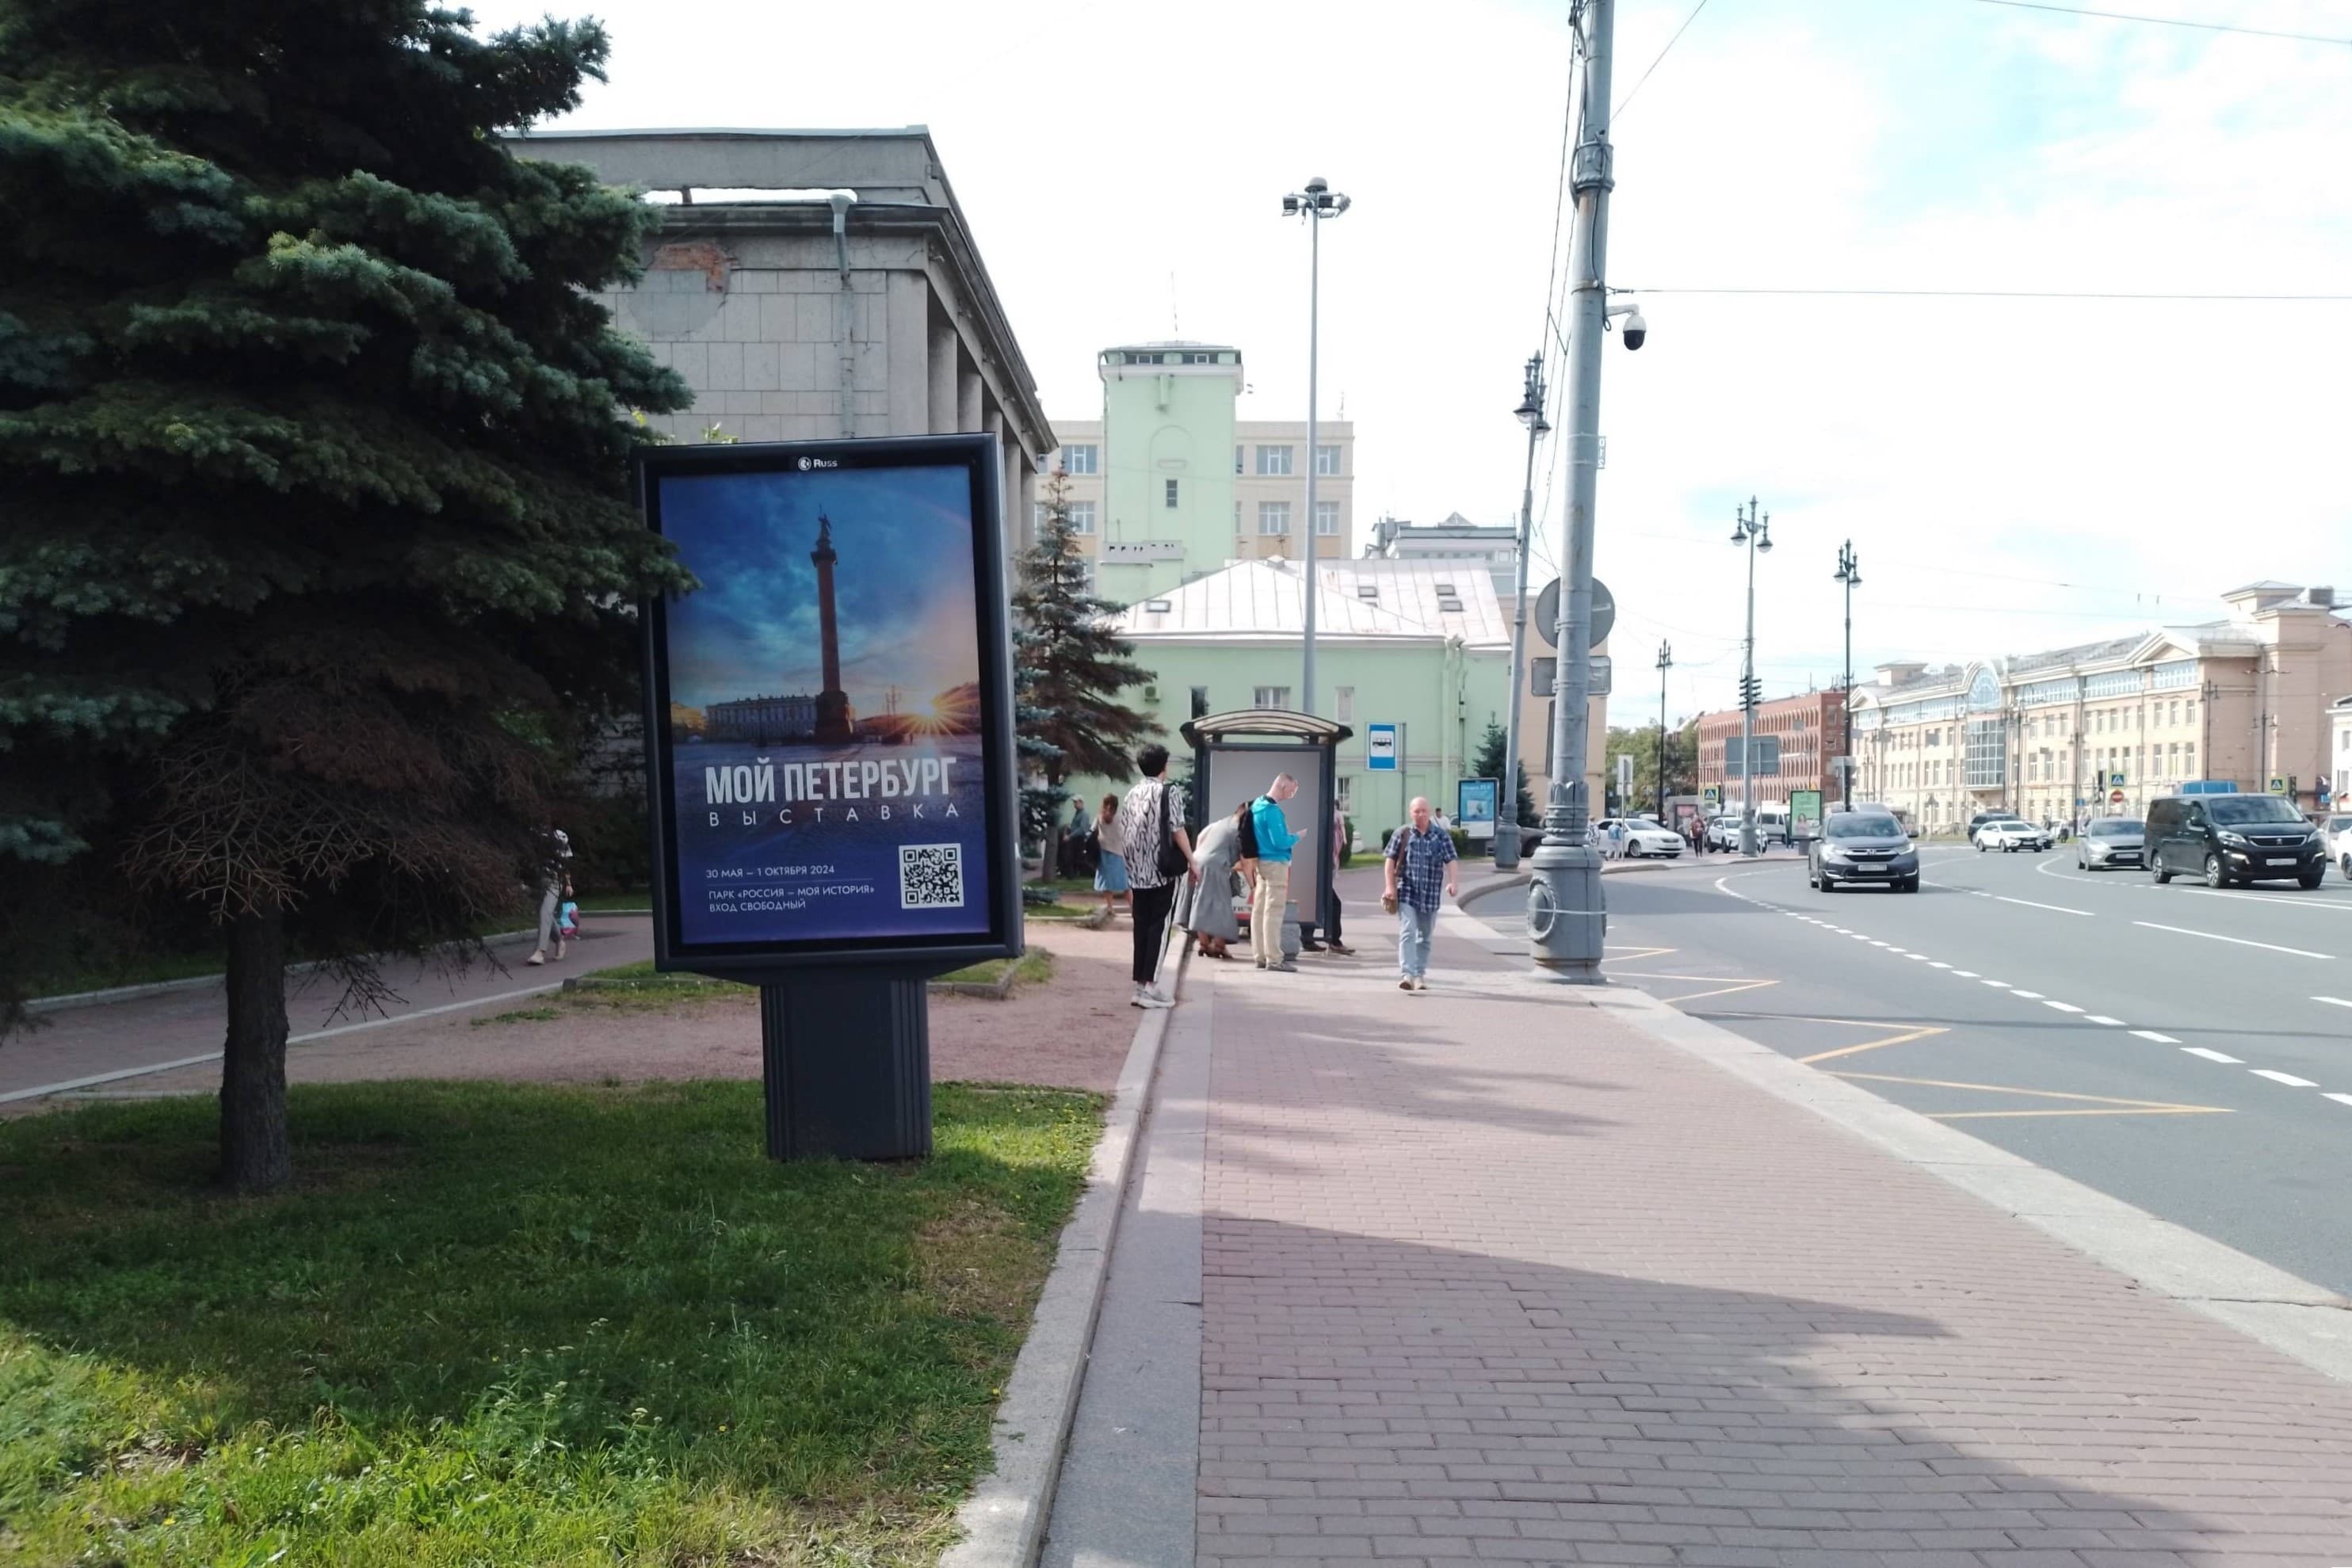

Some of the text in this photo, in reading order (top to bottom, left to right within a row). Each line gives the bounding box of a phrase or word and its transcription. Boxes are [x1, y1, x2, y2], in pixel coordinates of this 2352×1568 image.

[813, 458, 838, 467] Russ
[705, 757, 957, 804] МОЙ ПЕТЕРБУРГ
[708, 803, 960, 827] ВЫСТАВКА
[705, 869, 719, 879] 30
[721, 868, 743, 878] МАЯ
[757, 868, 762, 876] 1
[765, 865, 808, 876] ОКТЯБРЯ
[810, 864, 834, 875] 2024
[708, 890, 735, 900] ПАРК
[797, 887, 819, 896] МОЯ
[709, 898, 806, 913] ВХОД СВОБОДНЫЙ
